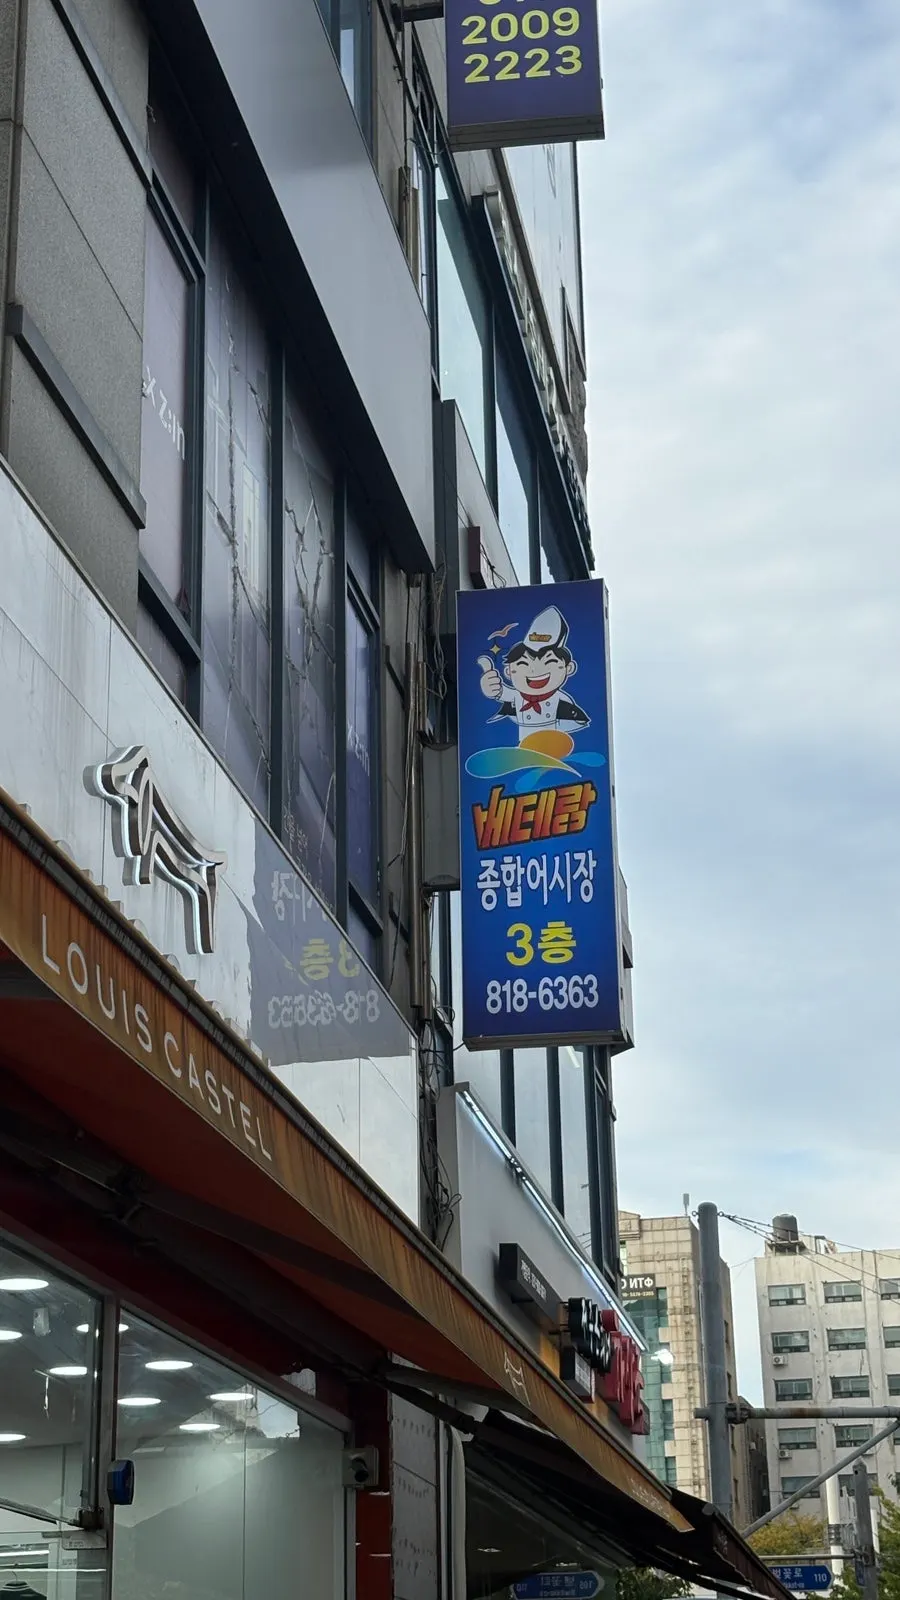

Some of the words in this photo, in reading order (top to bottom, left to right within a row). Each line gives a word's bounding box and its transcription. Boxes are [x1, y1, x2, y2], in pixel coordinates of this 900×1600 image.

[461, 7, 580, 45] 2009
[464, 45, 582, 83] 2223
[472, 780, 598, 850] 베테랑
[476, 850, 597, 912] 종합어시장
[505, 921, 577, 966] 3층
[485, 974, 599, 1014] 818-6363
[41, 914, 153, 1053] LOUIS
[164, 1031, 272, 1161] CASTEL
[813, 1573, 828, 1582] 110
